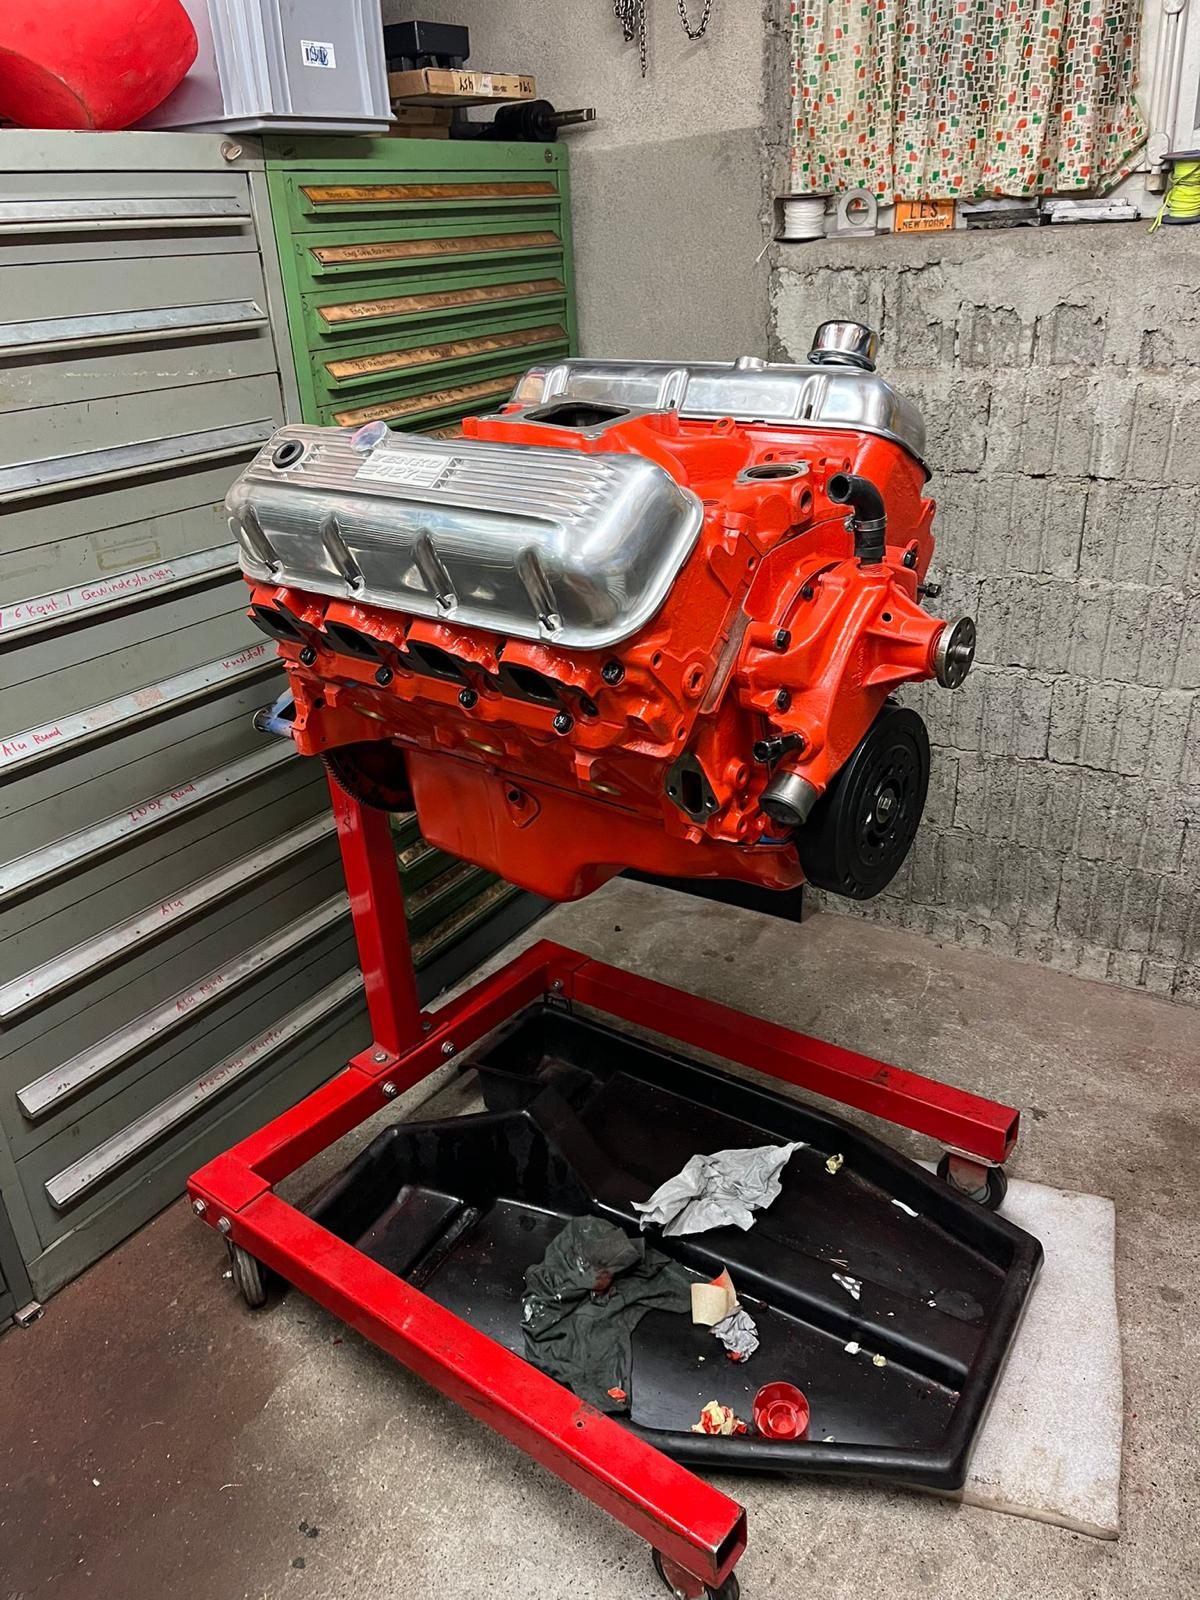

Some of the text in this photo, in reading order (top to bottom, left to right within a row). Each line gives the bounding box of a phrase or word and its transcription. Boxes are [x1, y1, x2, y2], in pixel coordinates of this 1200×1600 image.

[910, 201, 938, 219] LES
[902, 216, 946, 229] NEW YORK
[2, 726, 63, 757] Alu Rund
[170, 783, 197, 802] Rund
[161, 900, 185, 916] Alu
